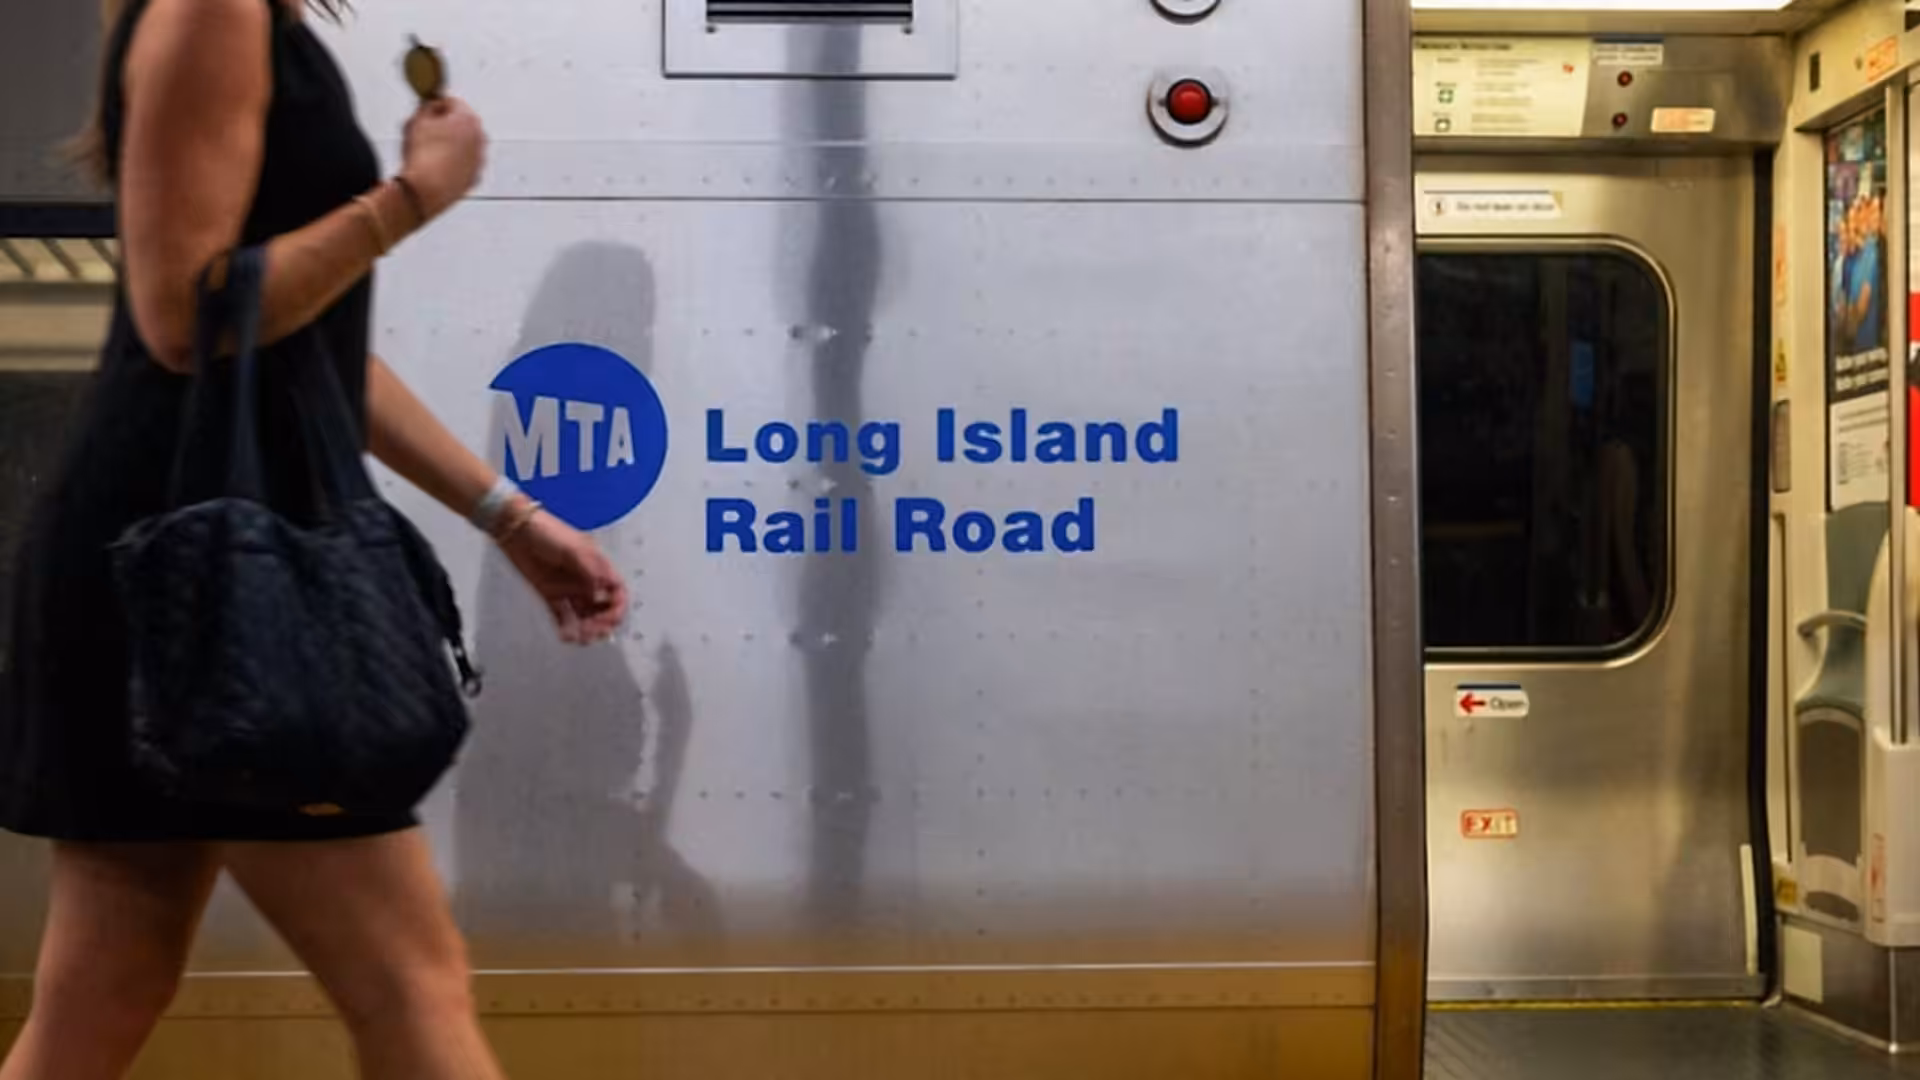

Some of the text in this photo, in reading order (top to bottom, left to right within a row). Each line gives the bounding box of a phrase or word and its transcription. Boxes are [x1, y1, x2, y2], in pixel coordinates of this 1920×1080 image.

[490, 388, 636, 482] MTA
[705, 408, 1179, 476] Long Island
[705, 497, 1095, 555] Rail Road
[1464, 815, 1515, 833] EXIT
